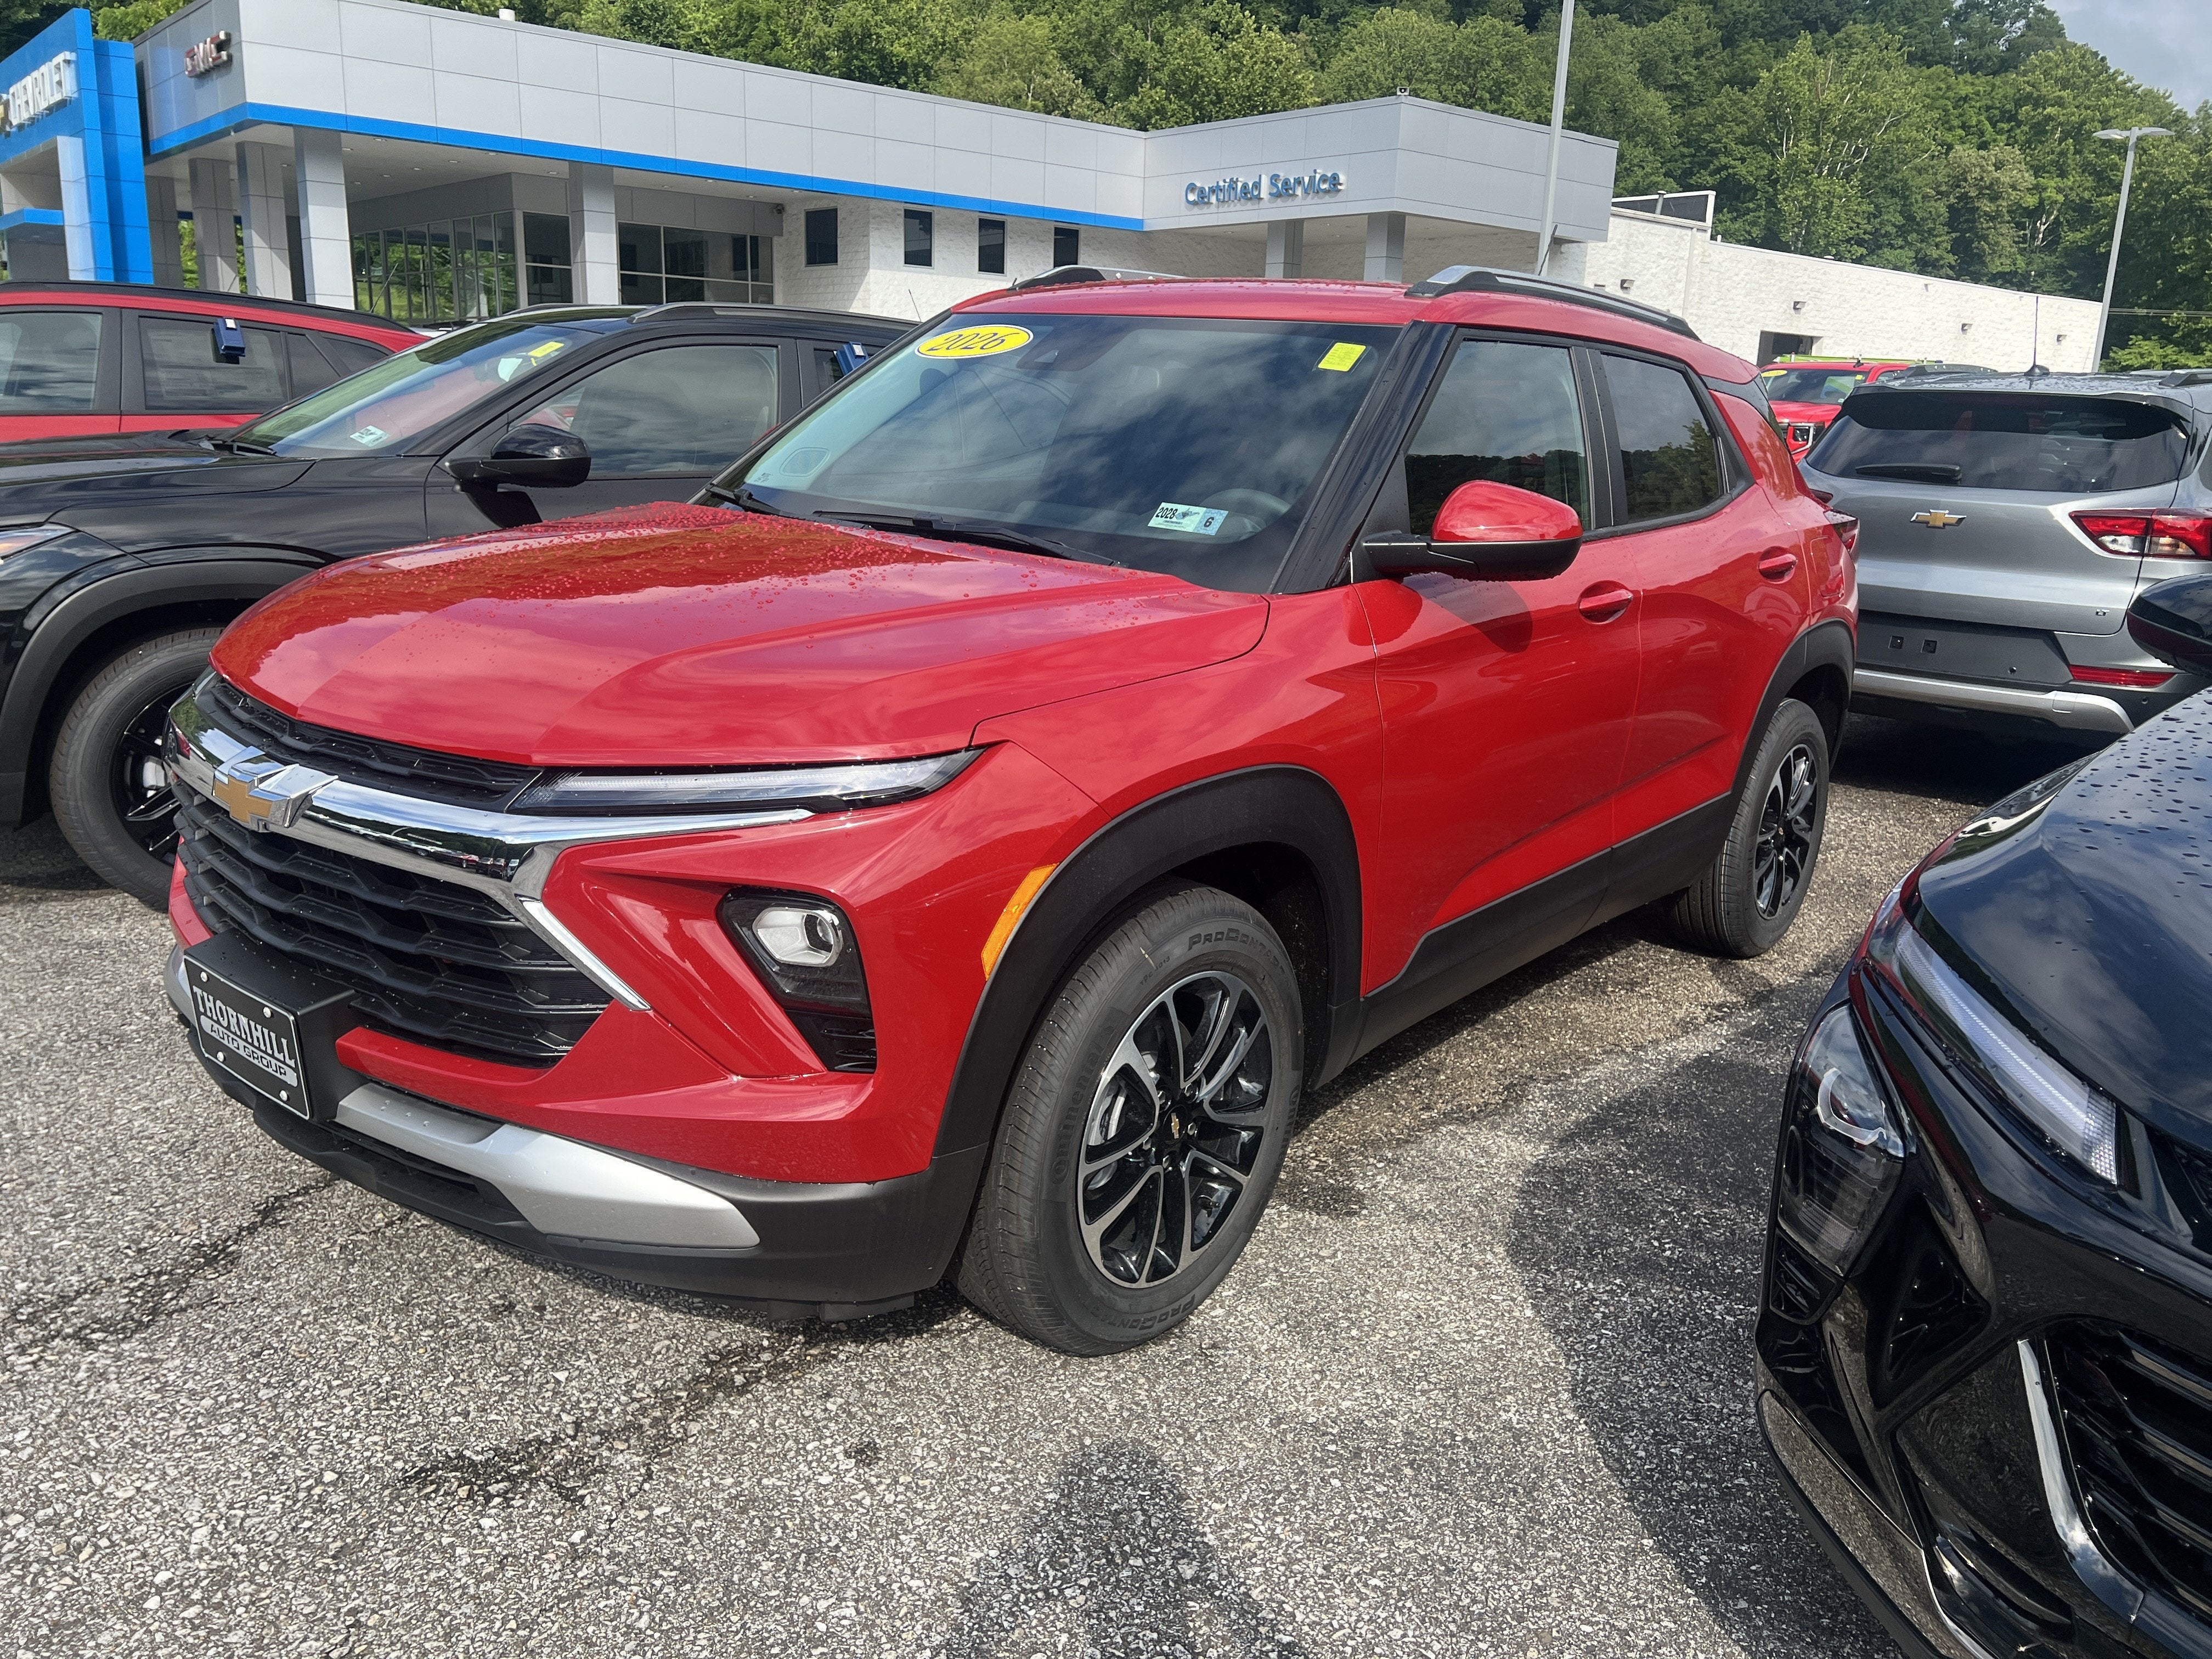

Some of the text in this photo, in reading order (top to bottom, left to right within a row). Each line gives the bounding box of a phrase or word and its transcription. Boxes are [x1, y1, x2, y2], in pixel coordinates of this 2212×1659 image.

[185, 30, 228, 76] GMC
[9, 51, 78, 126] CHEVROLET
[1184, 169, 1342, 205] Certified Service
[925, 332, 1021, 352] 2026
[1155, 506, 1178, 520] 2028
[1203, 516, 1215, 528] 6
[193, 985, 296, 1068] THORNHILL
[210, 1024, 287, 1076] AUTO GROUP
